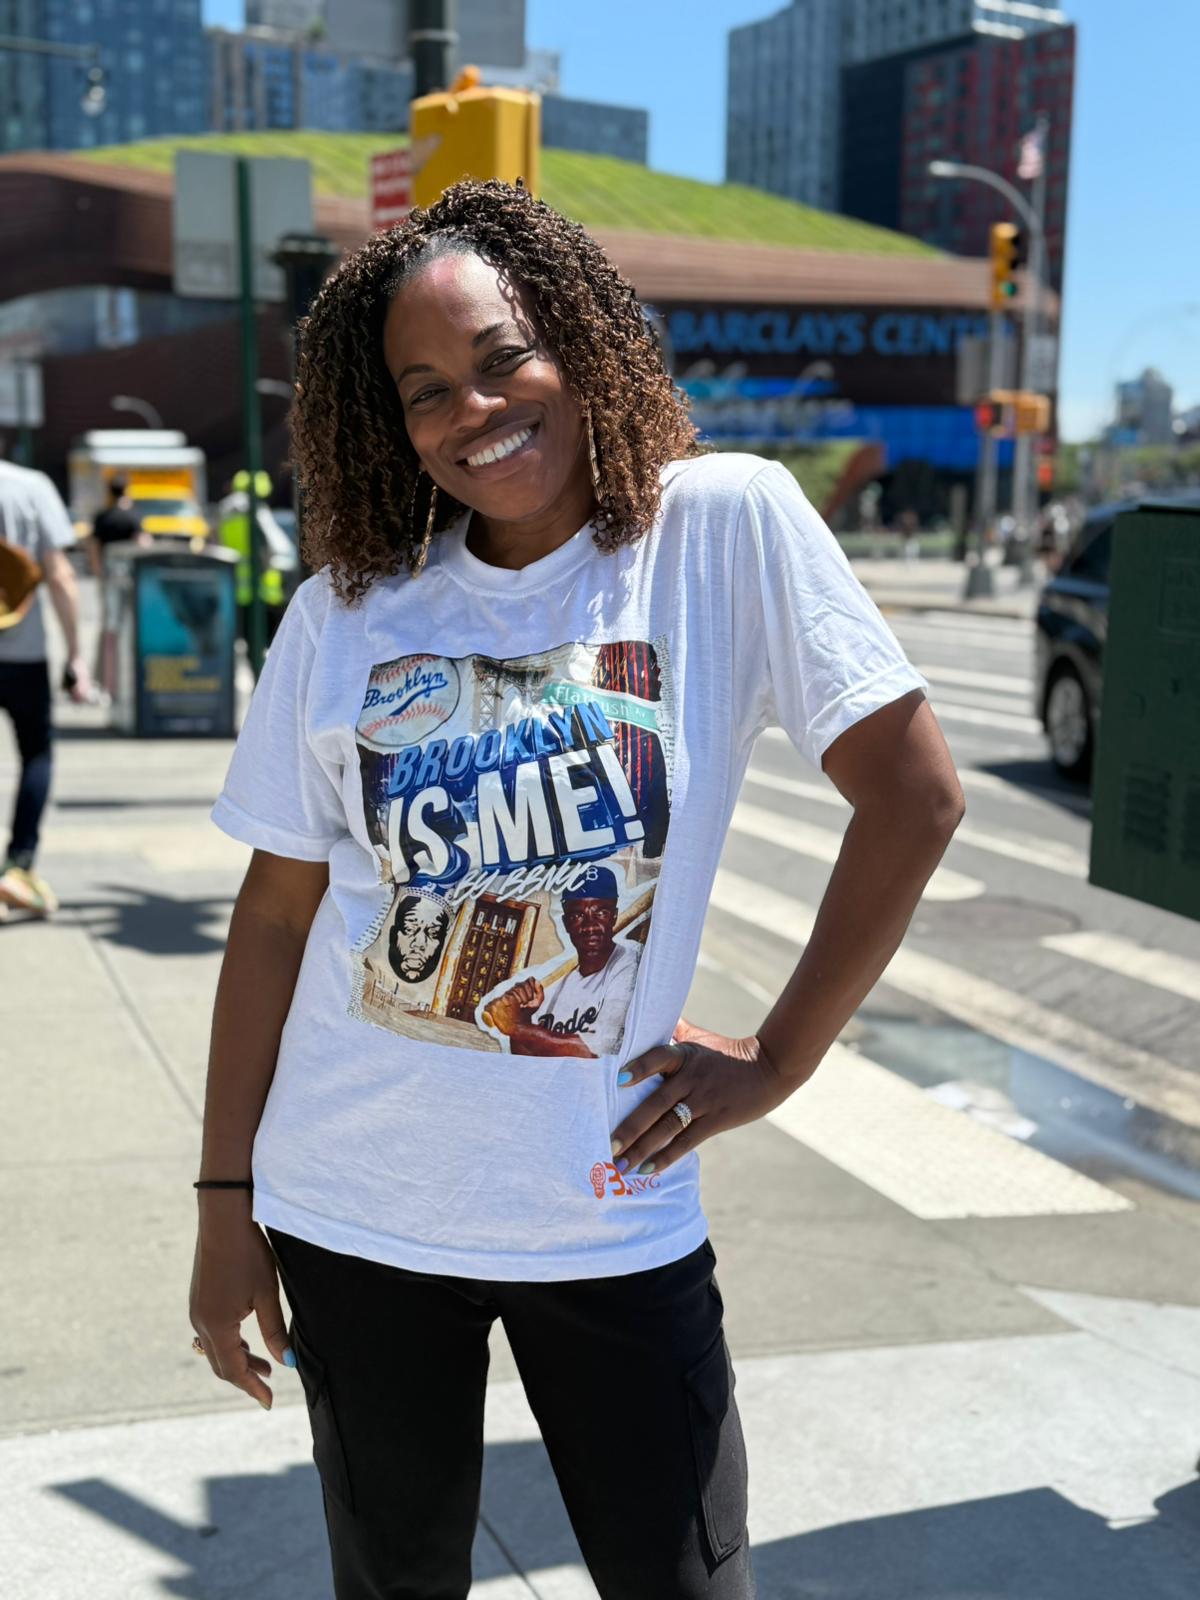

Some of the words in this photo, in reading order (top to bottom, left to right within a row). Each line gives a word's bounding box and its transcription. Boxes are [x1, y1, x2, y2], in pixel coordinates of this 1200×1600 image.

[669, 311, 865, 354] BARCLAYS
[362, 664, 448, 715] Brooklyn
[388, 702, 614, 795] BROOKLYN
[388, 785, 450, 884] IS
[477, 743, 645, 866] ME!
